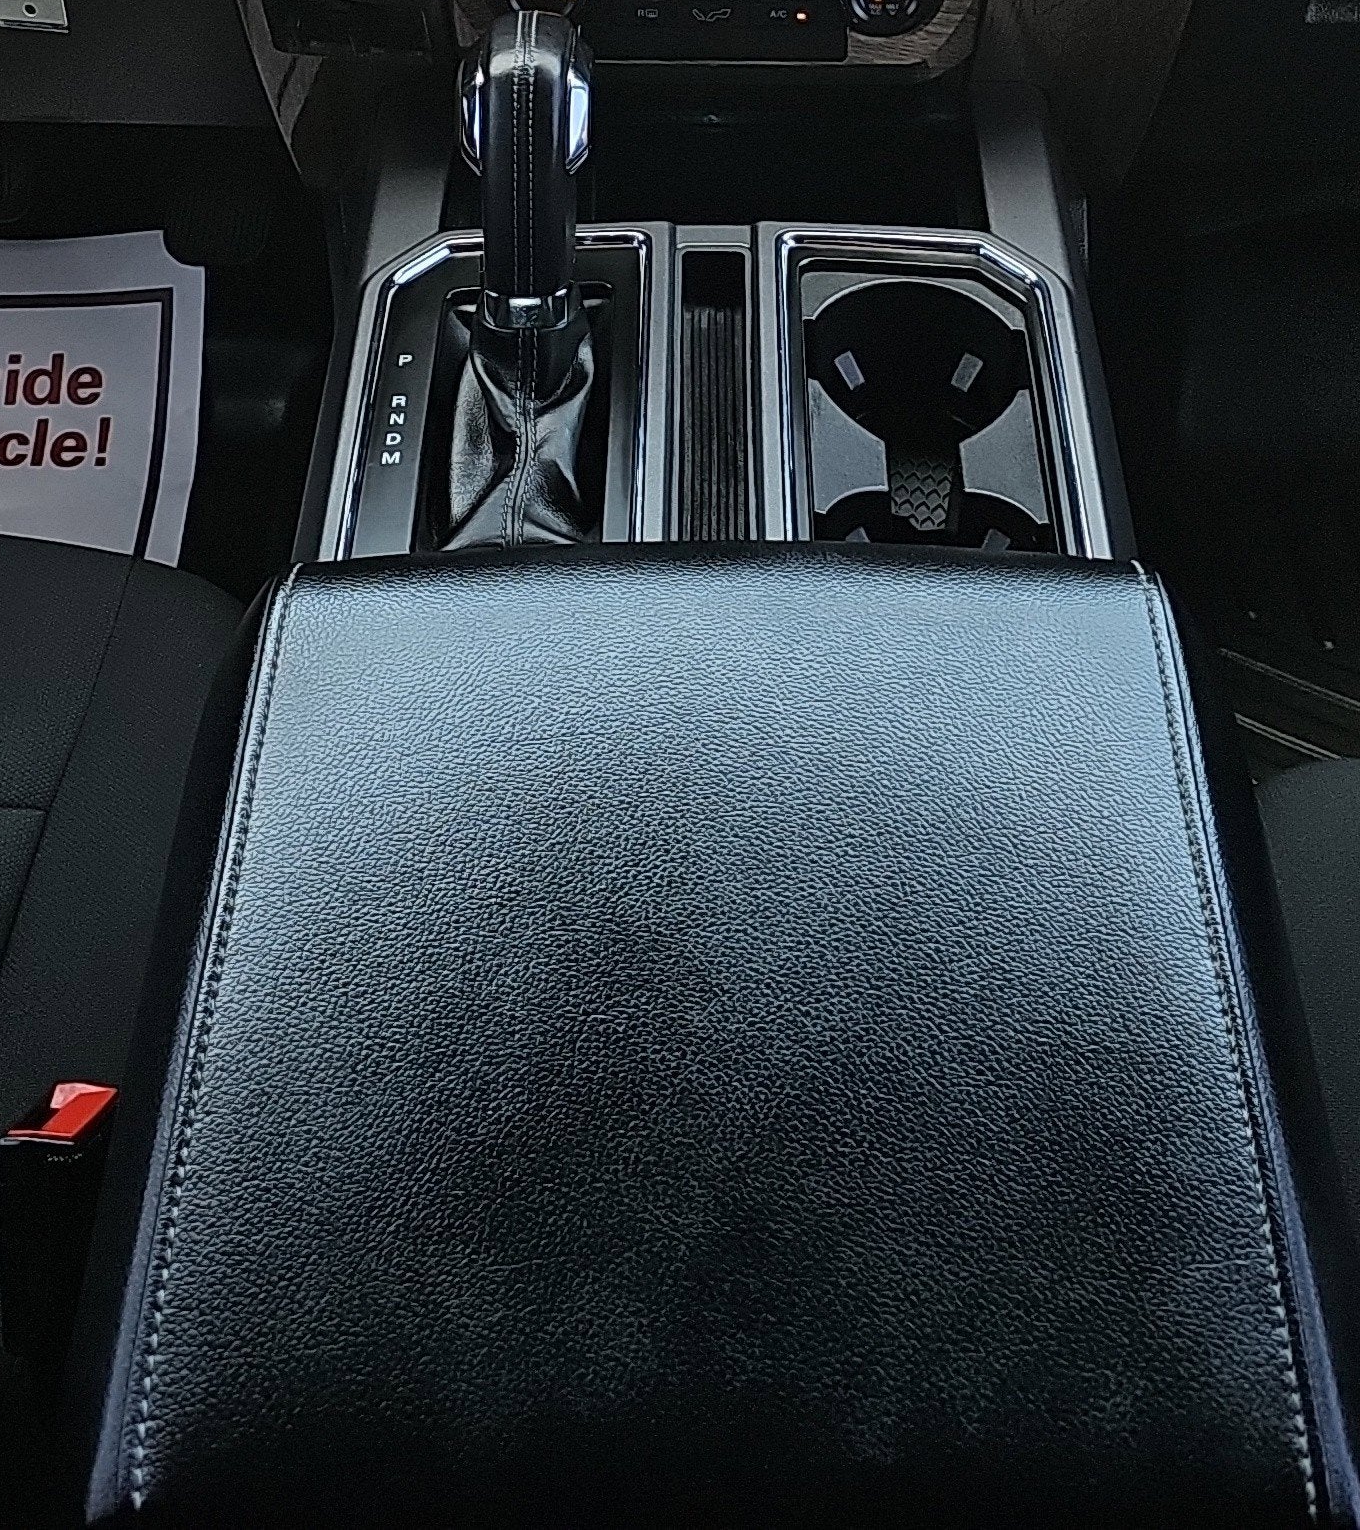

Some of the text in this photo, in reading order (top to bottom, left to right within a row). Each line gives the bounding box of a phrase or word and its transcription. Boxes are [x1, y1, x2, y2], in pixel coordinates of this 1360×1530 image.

[769, 10, 787, 19] A/C
[397, 354, 413, 367] P
[391, 394, 406, 407] R
[389, 413, 405, 425] N
[385, 433, 401, 446] D
[381, 452, 401, 465] M
